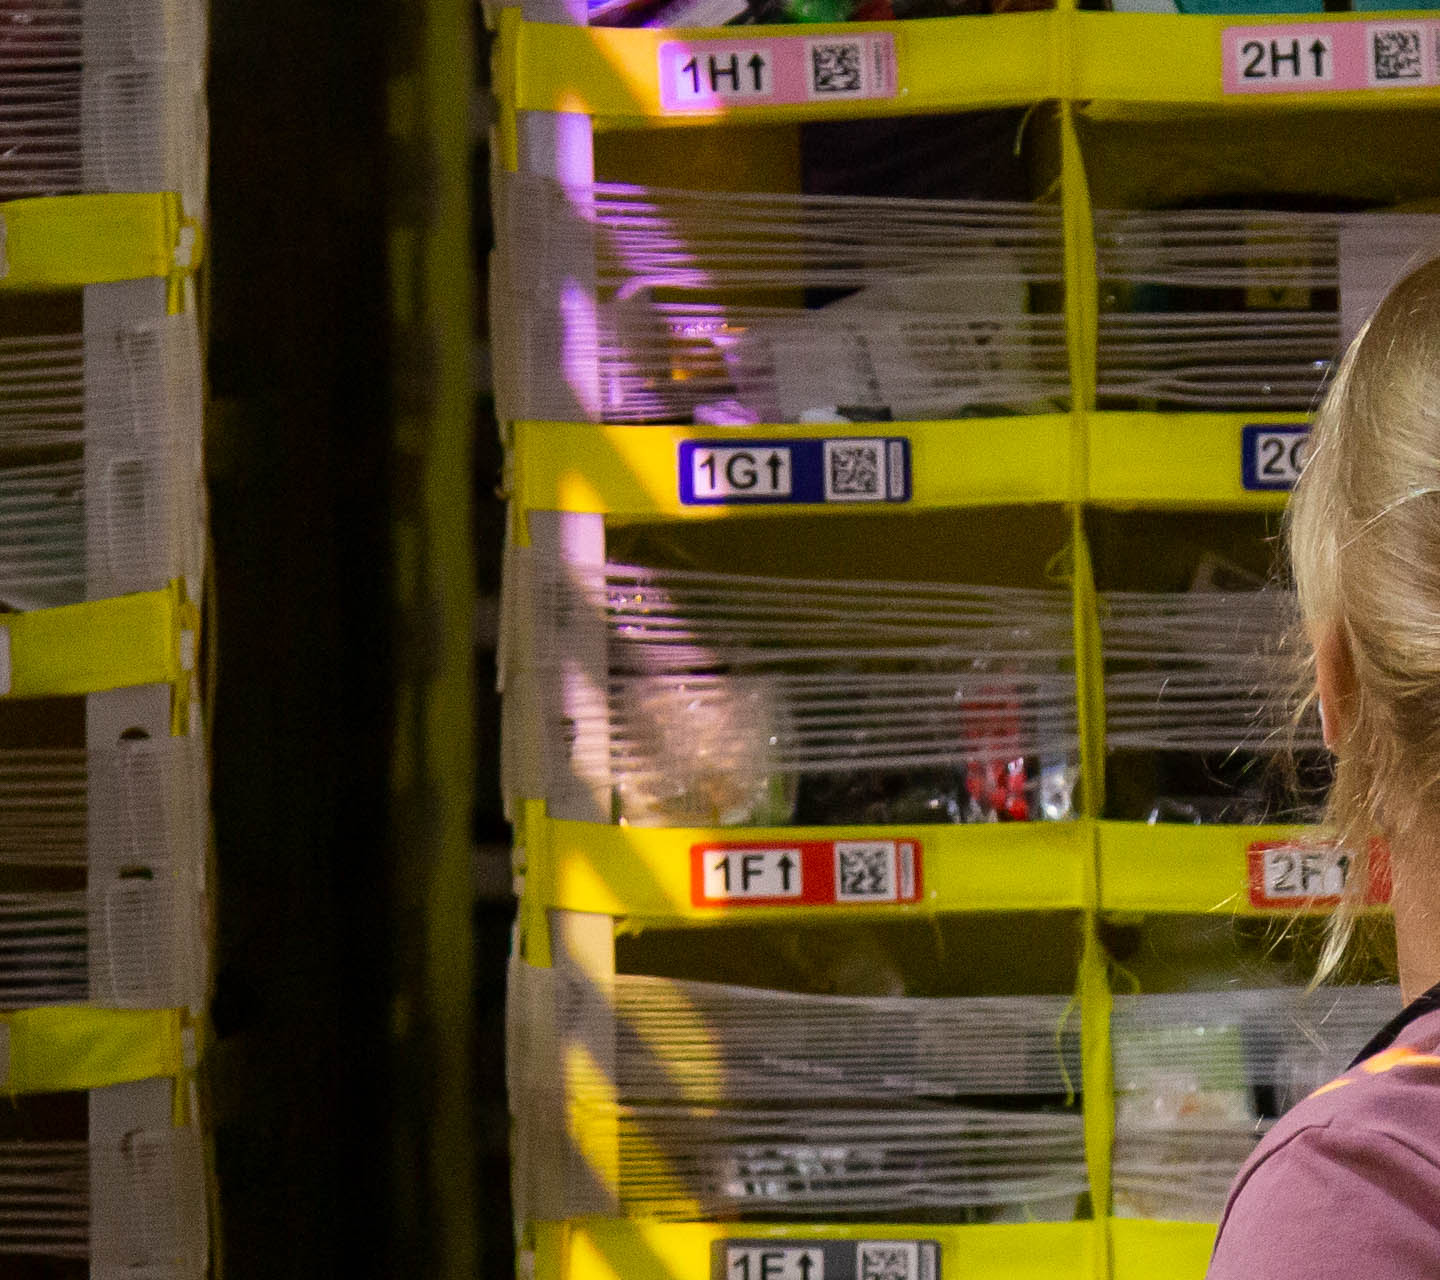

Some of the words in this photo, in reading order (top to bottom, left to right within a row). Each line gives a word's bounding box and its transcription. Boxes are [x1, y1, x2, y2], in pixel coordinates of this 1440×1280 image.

[684, 52, 741, 93] 1H
[1242, 40, 1301, 80] 2H
[701, 447, 760, 493] 1G
[717, 851, 765, 893] 1F
